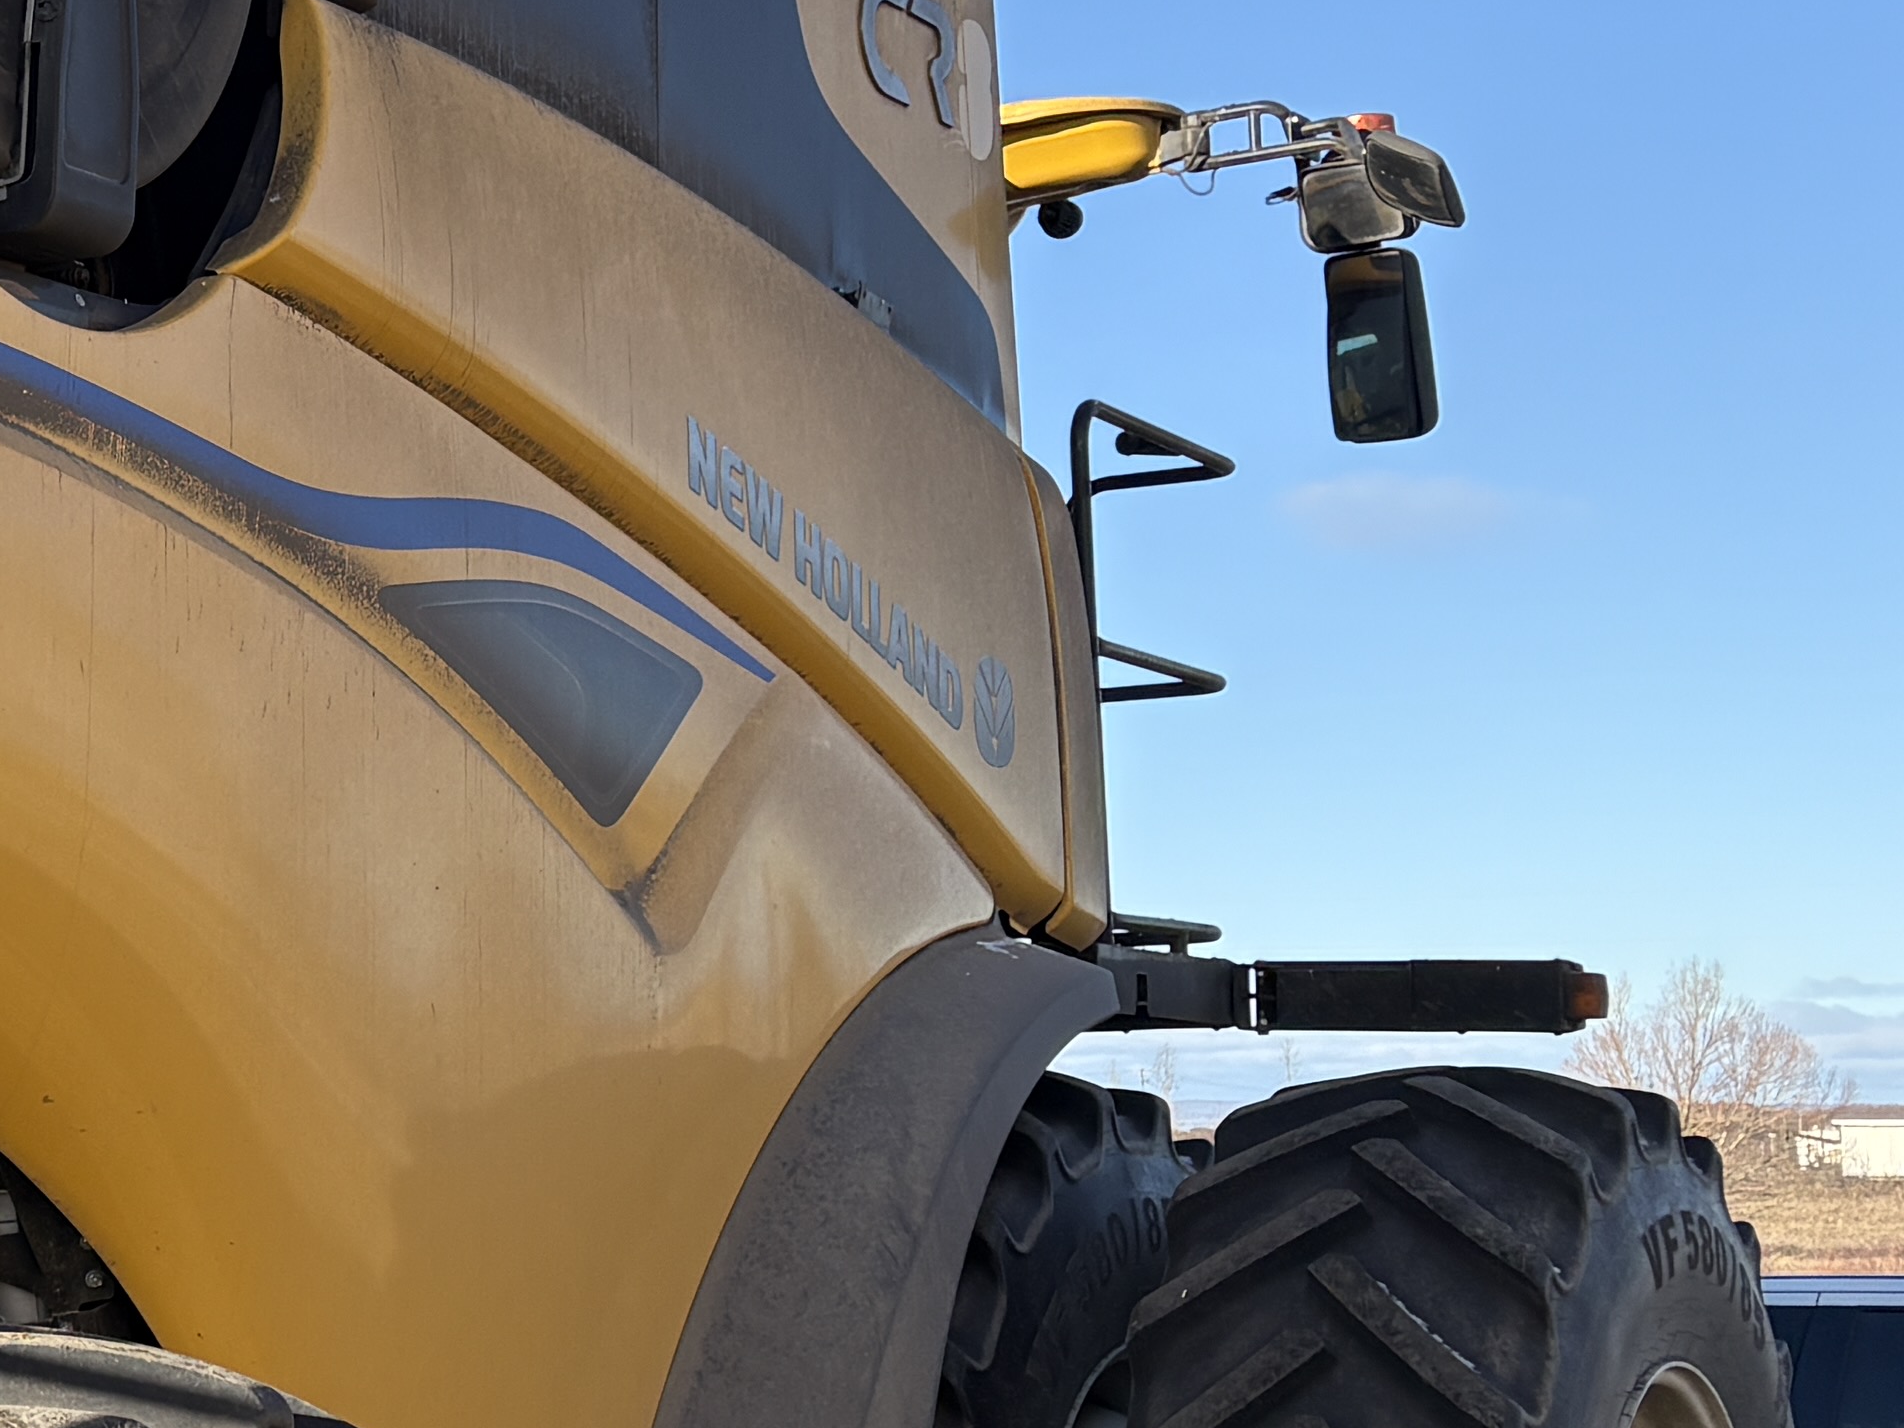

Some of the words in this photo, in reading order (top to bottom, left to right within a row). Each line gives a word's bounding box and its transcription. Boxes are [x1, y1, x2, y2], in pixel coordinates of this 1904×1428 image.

[686, 413, 784, 562] NEW
[793, 506, 965, 731] HOLLAND
[1641, 1213, 1679, 1290] VF
